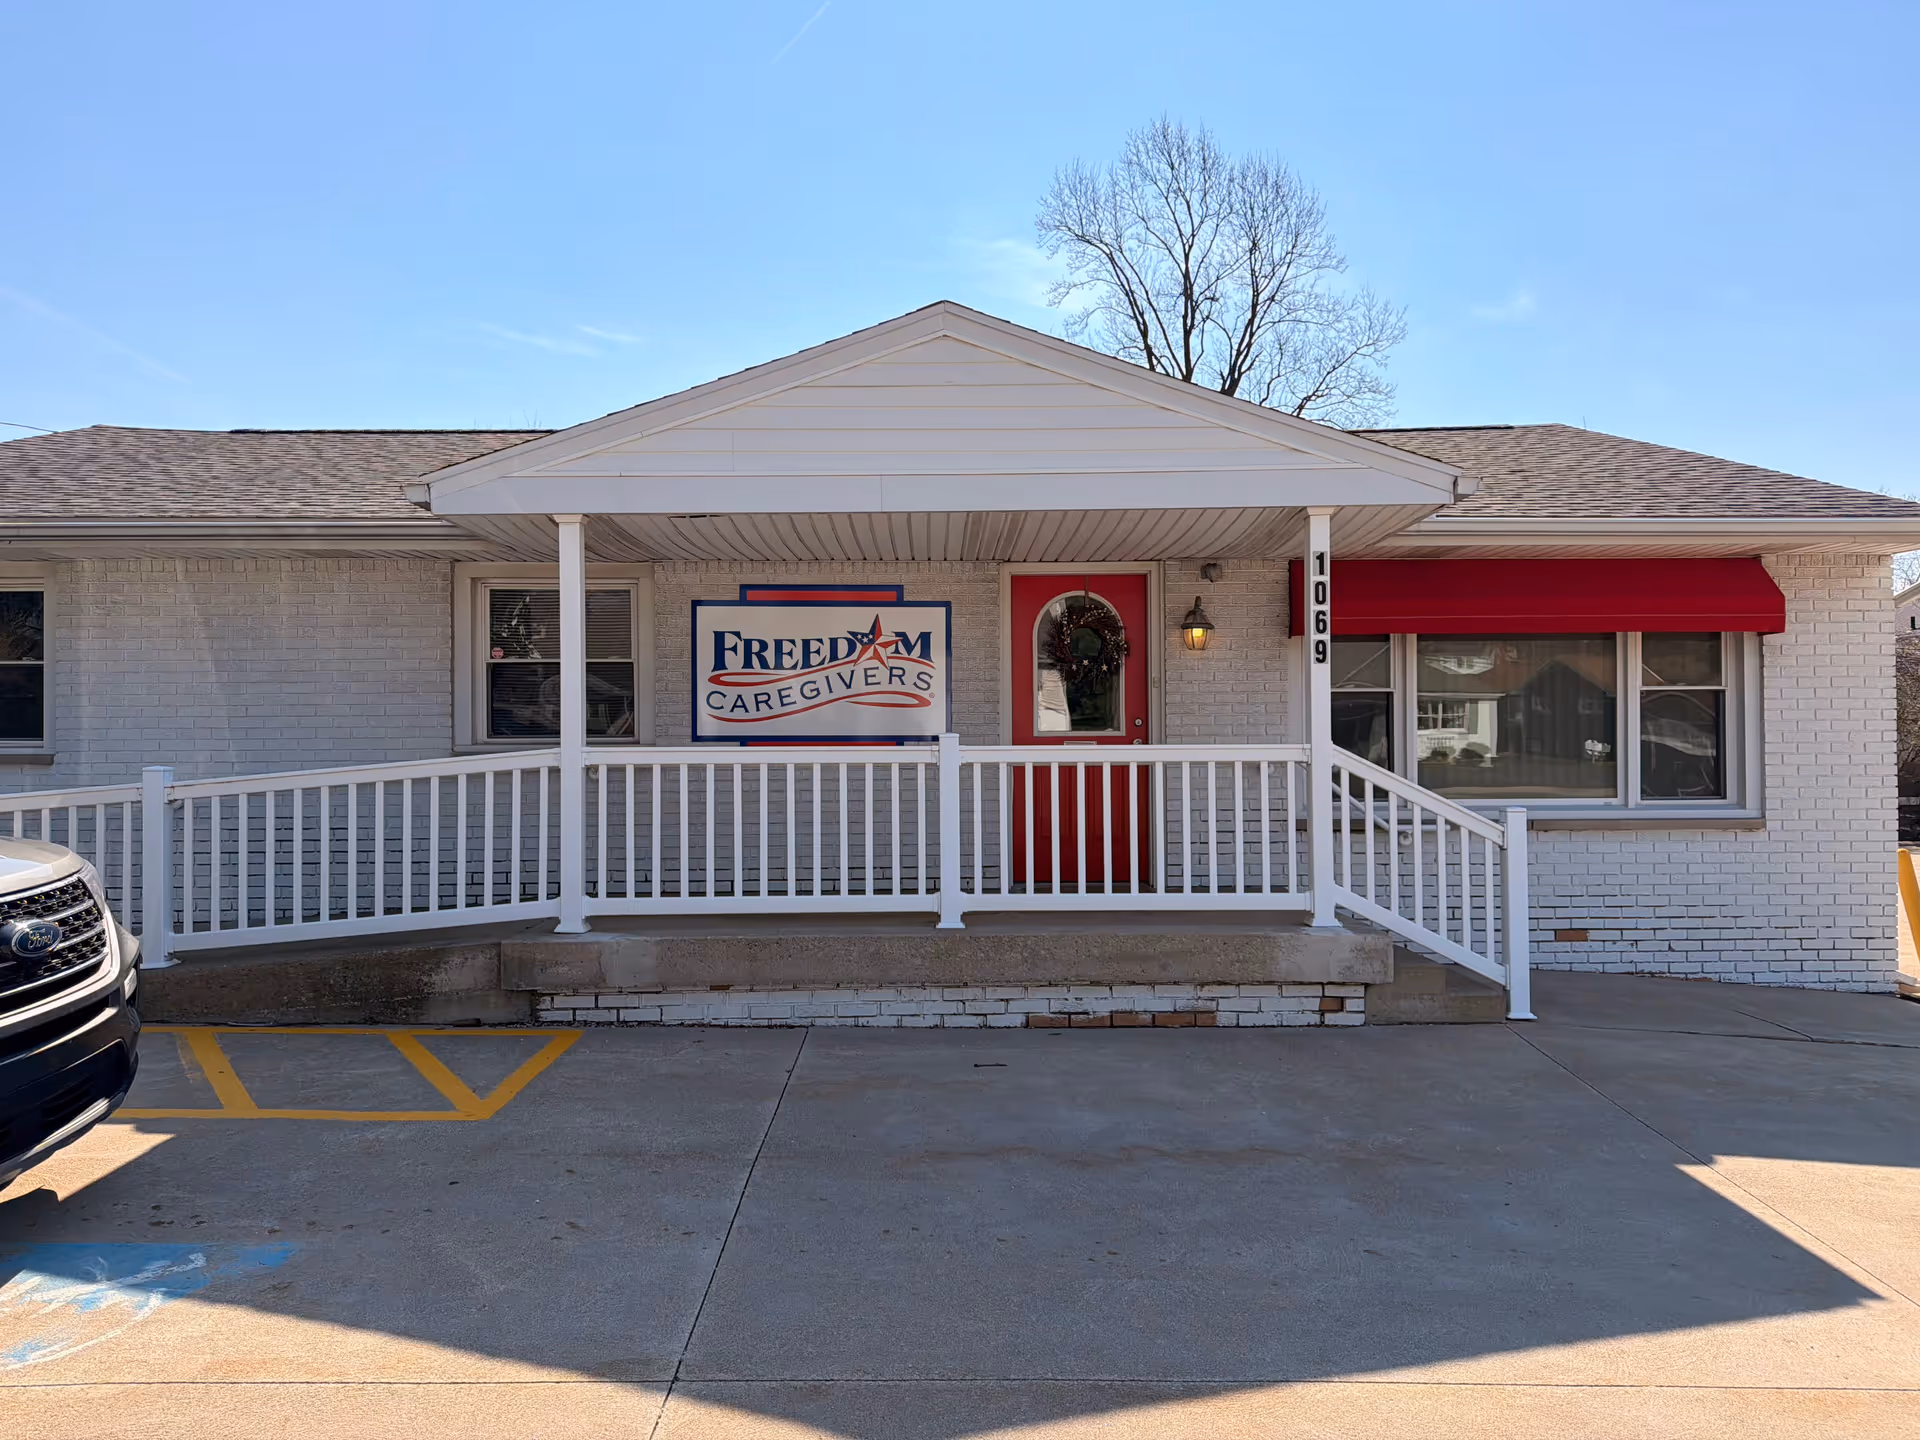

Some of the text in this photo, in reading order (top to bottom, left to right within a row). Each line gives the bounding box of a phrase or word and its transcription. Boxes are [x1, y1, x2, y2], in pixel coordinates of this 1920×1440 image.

[1315, 552, 1328, 664] 1069
[711, 630, 933, 672] FREEDM
[706, 666, 934, 713] CAREGIVERS
[28, 928, 54, 949] Ford
